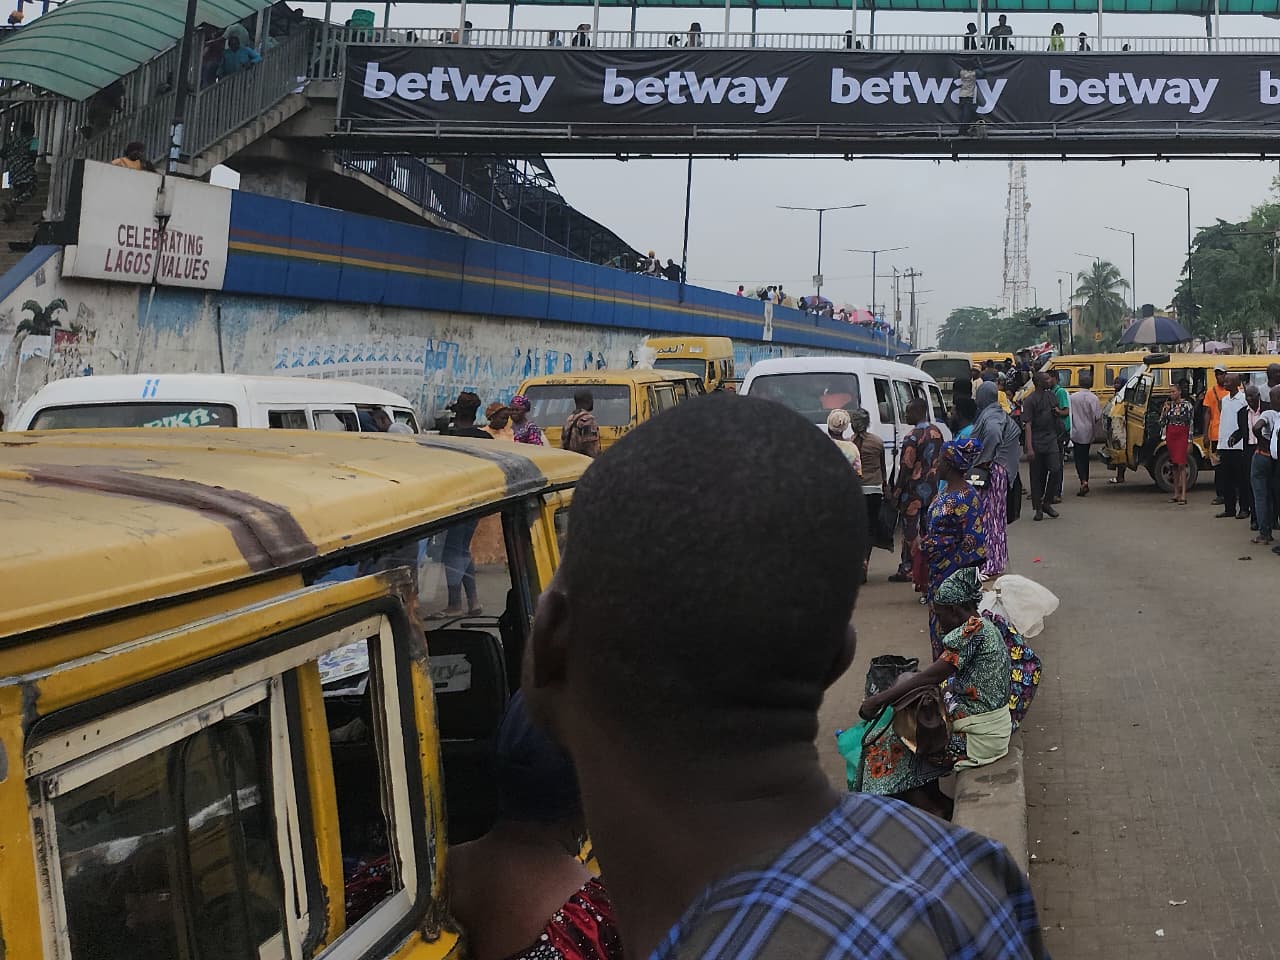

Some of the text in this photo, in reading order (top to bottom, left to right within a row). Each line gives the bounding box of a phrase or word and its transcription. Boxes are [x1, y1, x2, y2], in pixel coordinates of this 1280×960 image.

[364, 63, 556, 113] betway
[604, 69, 788, 113] betway
[1049, 70, 1219, 114] betway
[117, 224, 204, 256] CELEBRATING
[104, 248, 210, 281] LAGOS VALUES
